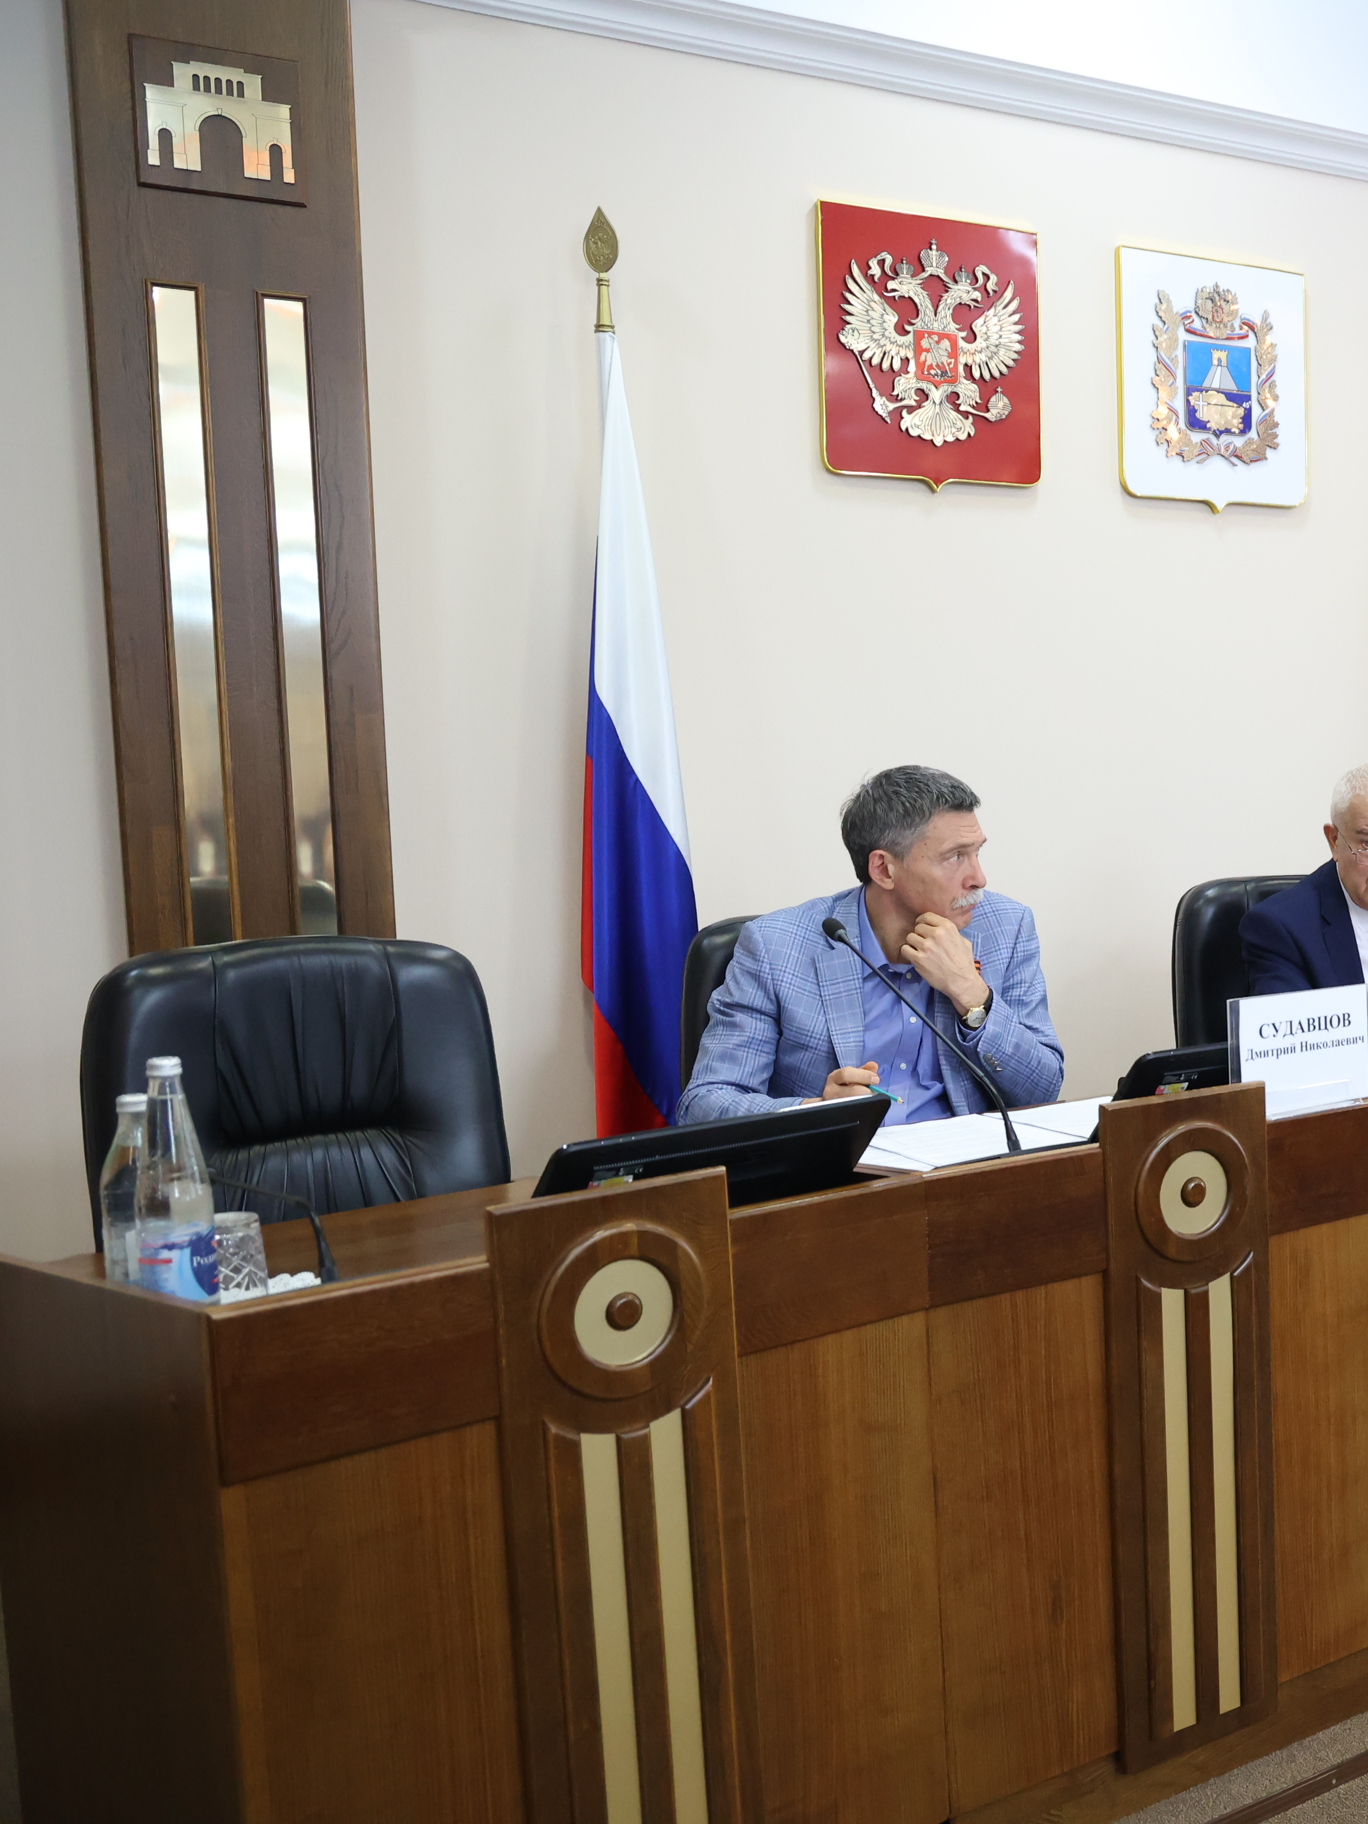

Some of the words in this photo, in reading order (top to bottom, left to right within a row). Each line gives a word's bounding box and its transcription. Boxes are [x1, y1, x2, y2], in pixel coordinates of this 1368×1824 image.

[1258, 1012, 1351, 1039] СУДАВЦОВ
[1245, 1043, 1296, 1062] Дмитрий
[1299, 1035, 1365, 1053] Николаевич
